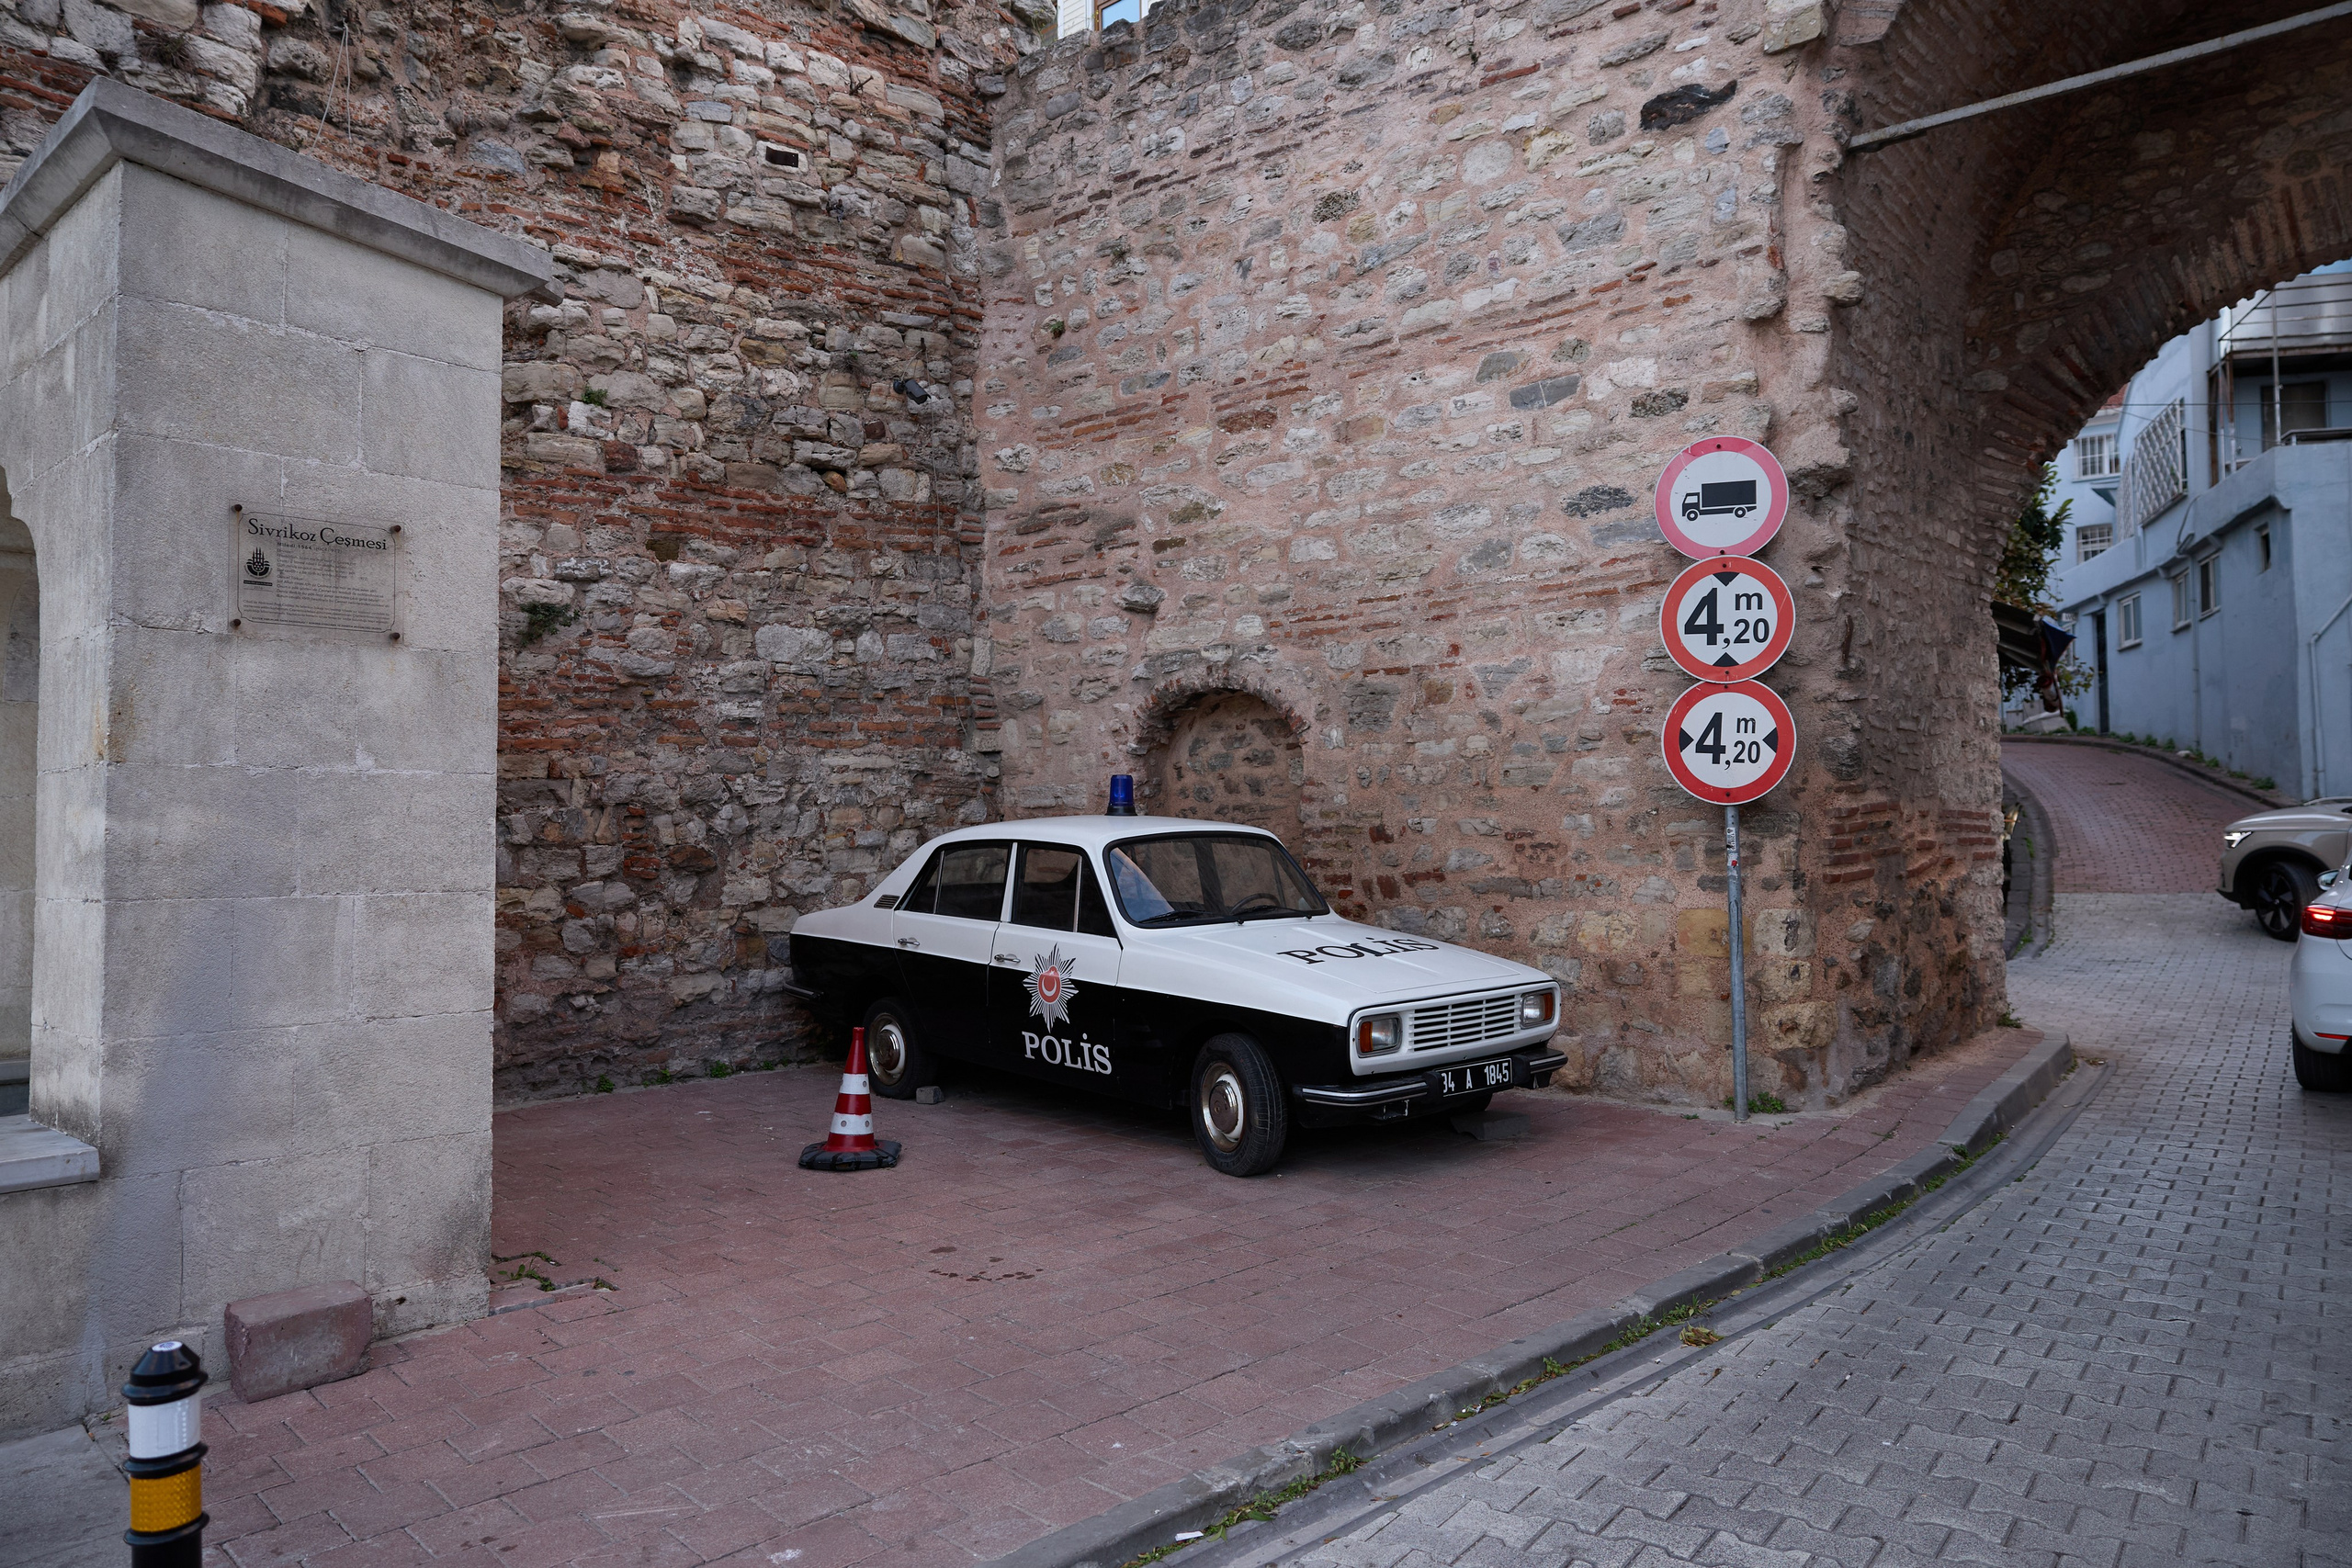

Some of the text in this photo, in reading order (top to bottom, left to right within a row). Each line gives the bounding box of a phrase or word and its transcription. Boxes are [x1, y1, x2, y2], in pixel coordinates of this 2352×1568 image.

[248, 518, 387, 550] Sivrikoz Çeşmesi
[1735, 592, 1763, 611] m
[1736, 717, 1757, 734] m
[1276, 937, 1440, 964] POLİS
[1022, 1031, 1113, 1075] POLİS
[1441, 1062, 1510, 1093] 34 A 1845
